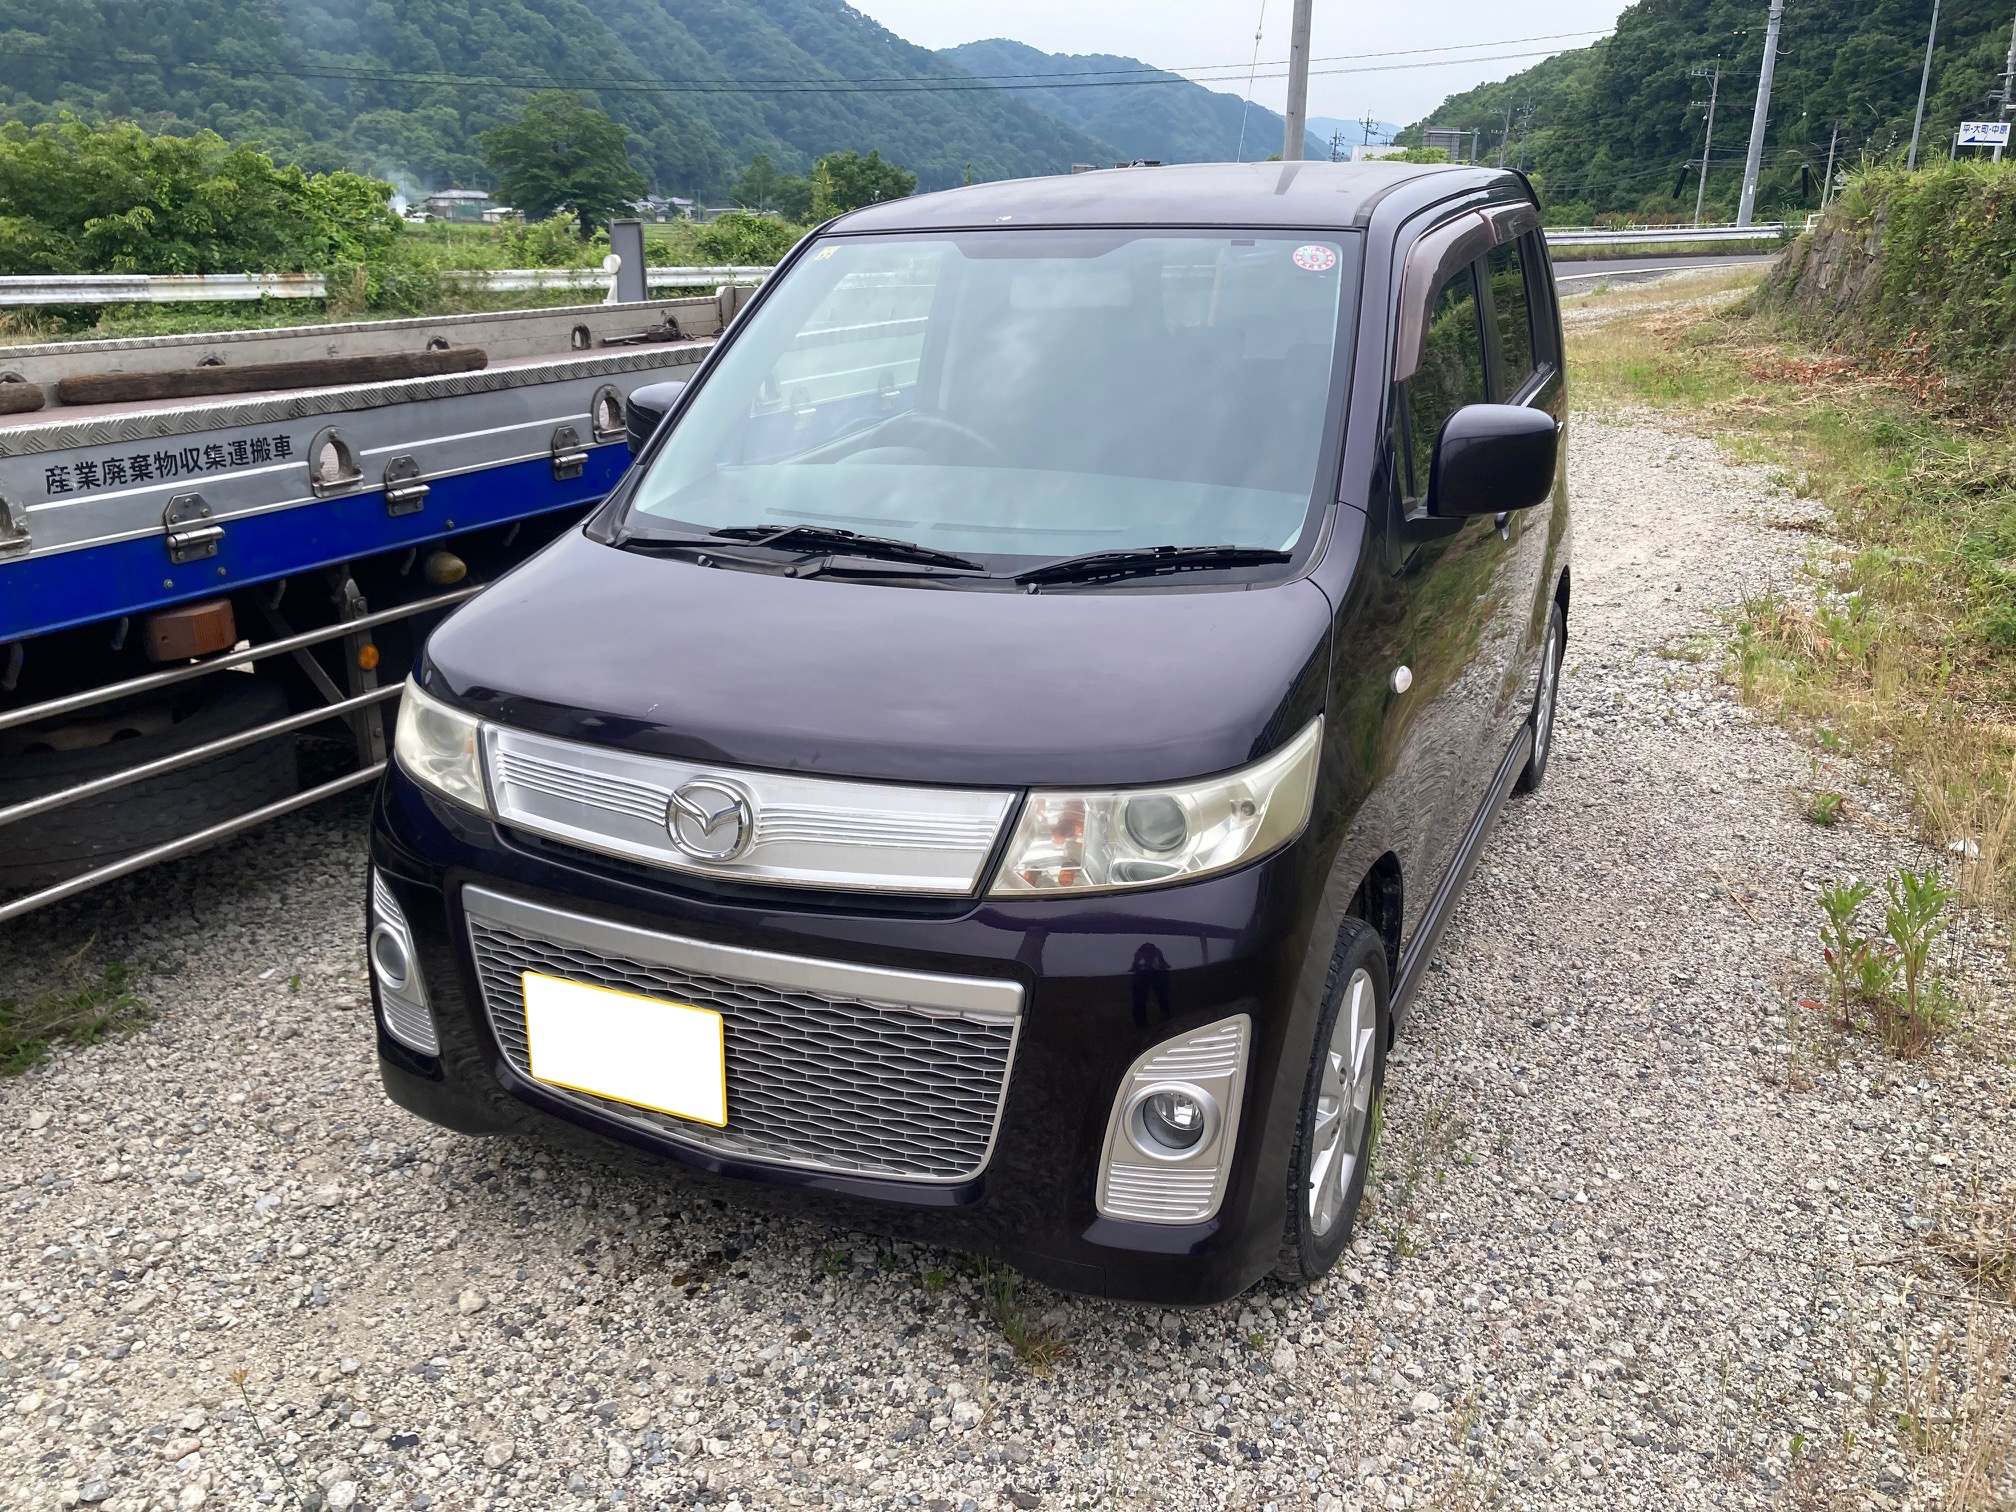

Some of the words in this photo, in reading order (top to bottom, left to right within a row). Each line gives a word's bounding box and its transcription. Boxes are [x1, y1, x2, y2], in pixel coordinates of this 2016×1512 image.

[45, 434, 294, 495] 産業廃棄物収集運搬車
